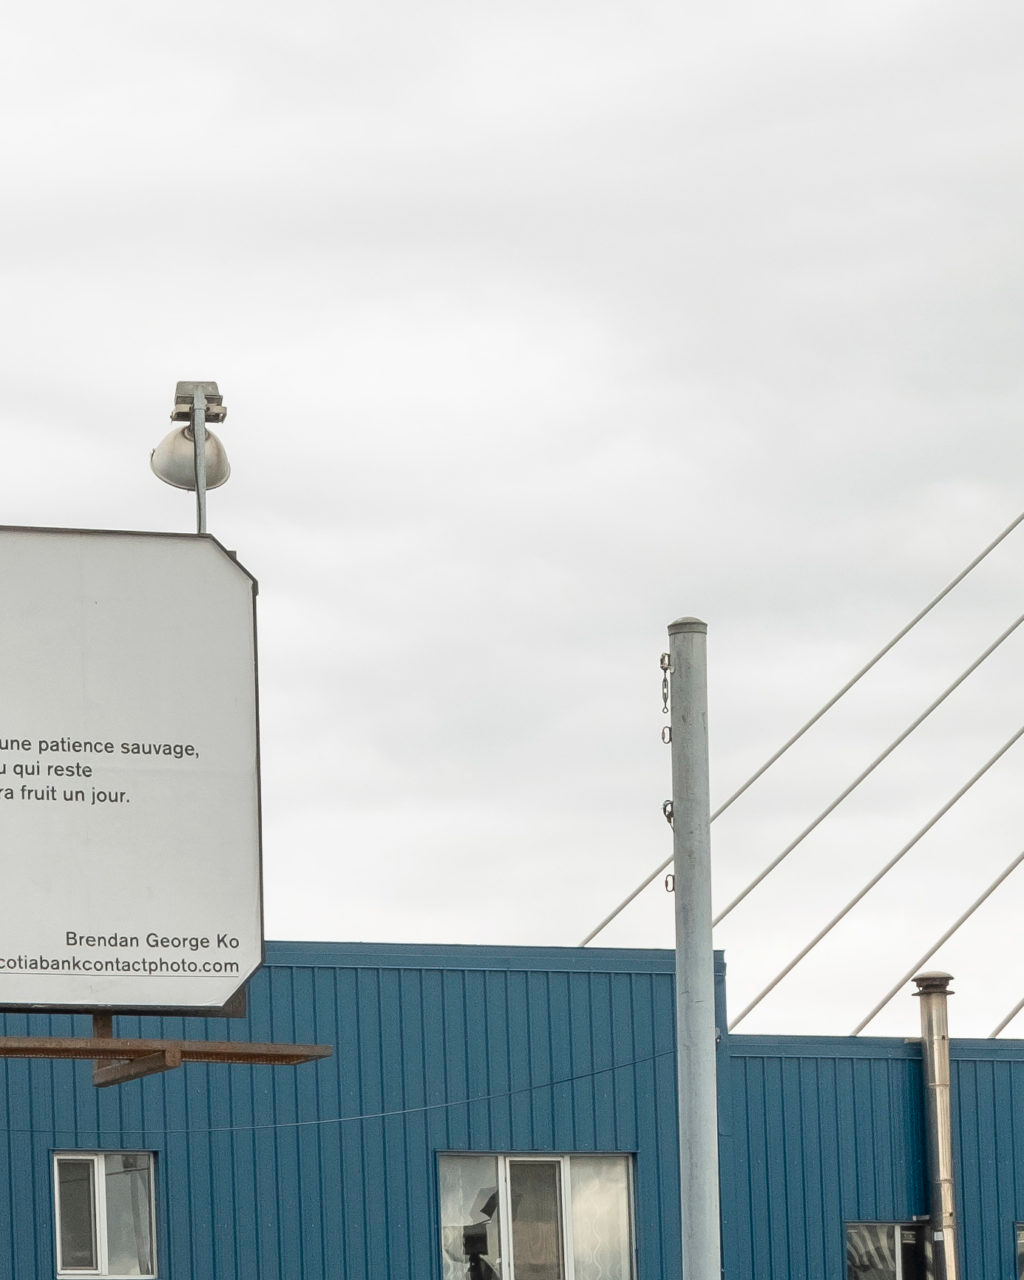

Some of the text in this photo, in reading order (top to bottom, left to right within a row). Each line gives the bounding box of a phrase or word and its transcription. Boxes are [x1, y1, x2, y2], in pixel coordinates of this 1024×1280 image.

[38, 737, 114, 755] patience
[120, 742, 200, 759] sauvage,
[13, 761, 40, 778] qui
[47, 763, 93, 777] reste
[20, 785, 57, 801] fruit
[63, 789, 85, 802] un
[91, 787, 130, 805] jour.
[66, 931, 240, 951] Brendan George Ko
